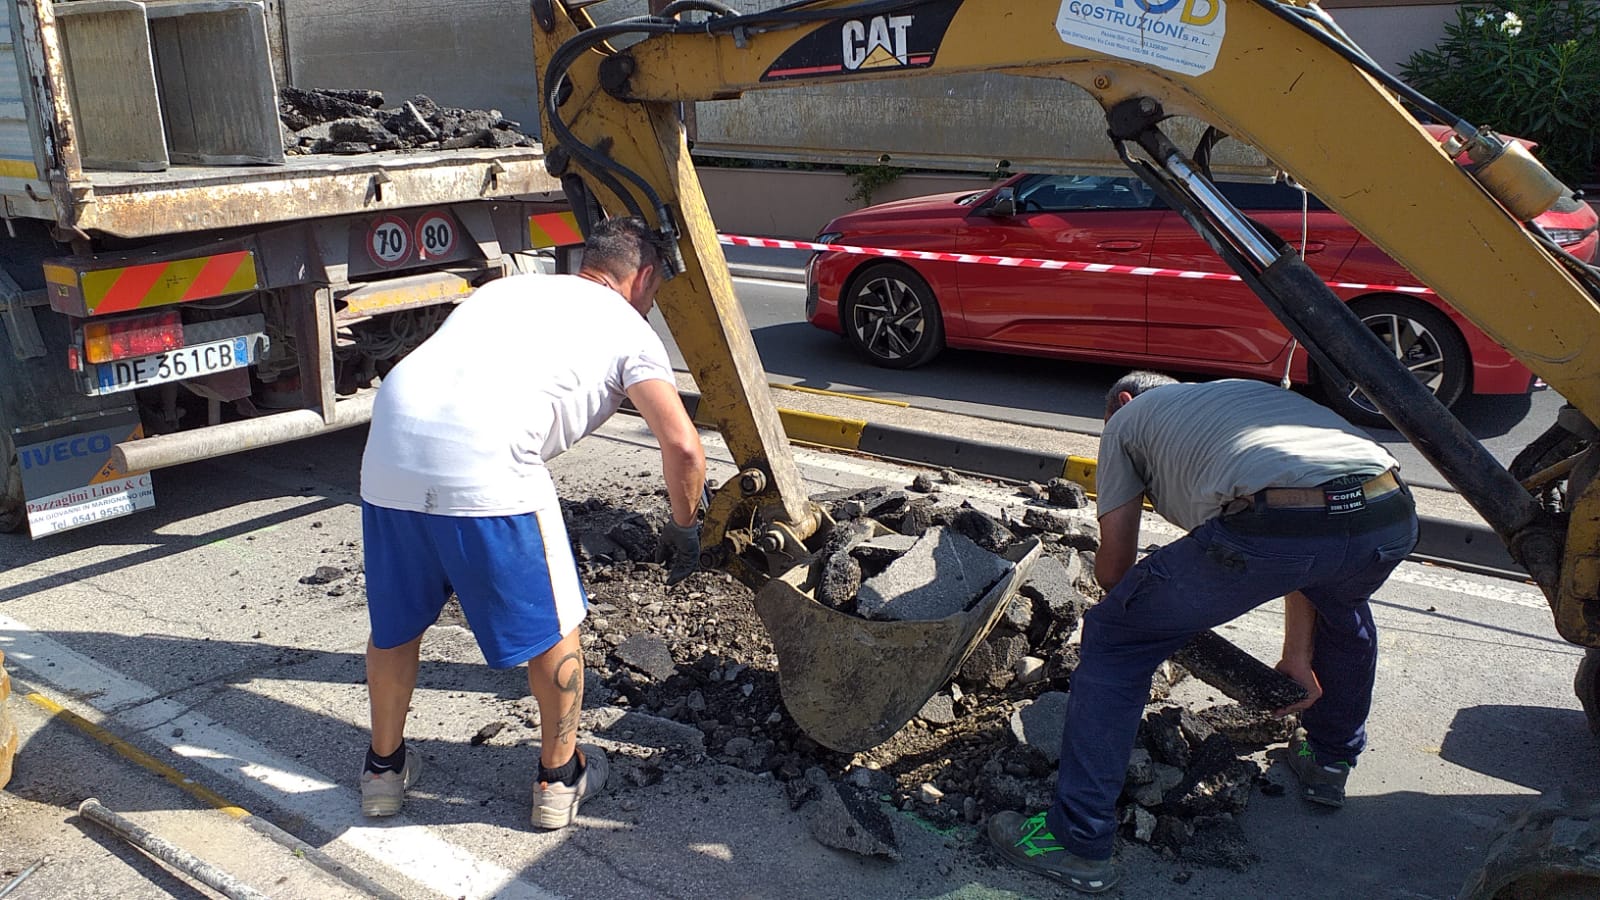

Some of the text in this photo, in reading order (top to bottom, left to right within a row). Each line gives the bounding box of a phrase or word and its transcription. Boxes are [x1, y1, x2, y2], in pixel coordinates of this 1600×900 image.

[1069, 1, 1184, 39] COSTRUZIONI
[842, 15, 913, 70] CAT
[377, 228, 402, 255] 70
[425, 224, 449, 249] 80
[21, 435, 112, 470] IVECO
[27, 488, 89, 513] Pazzaglini
[92, 483, 120, 499] Lino
[124, 479, 135, 491] &
[46, 506, 82, 521] GIOVANNI
[82, 503, 91, 511] IN
[92, 492, 138, 510] MARIGNANO
[1332, 489, 1362, 501] COFRA
[72, 511, 96, 526] 0541
[100, 503, 137, 517] 955301
